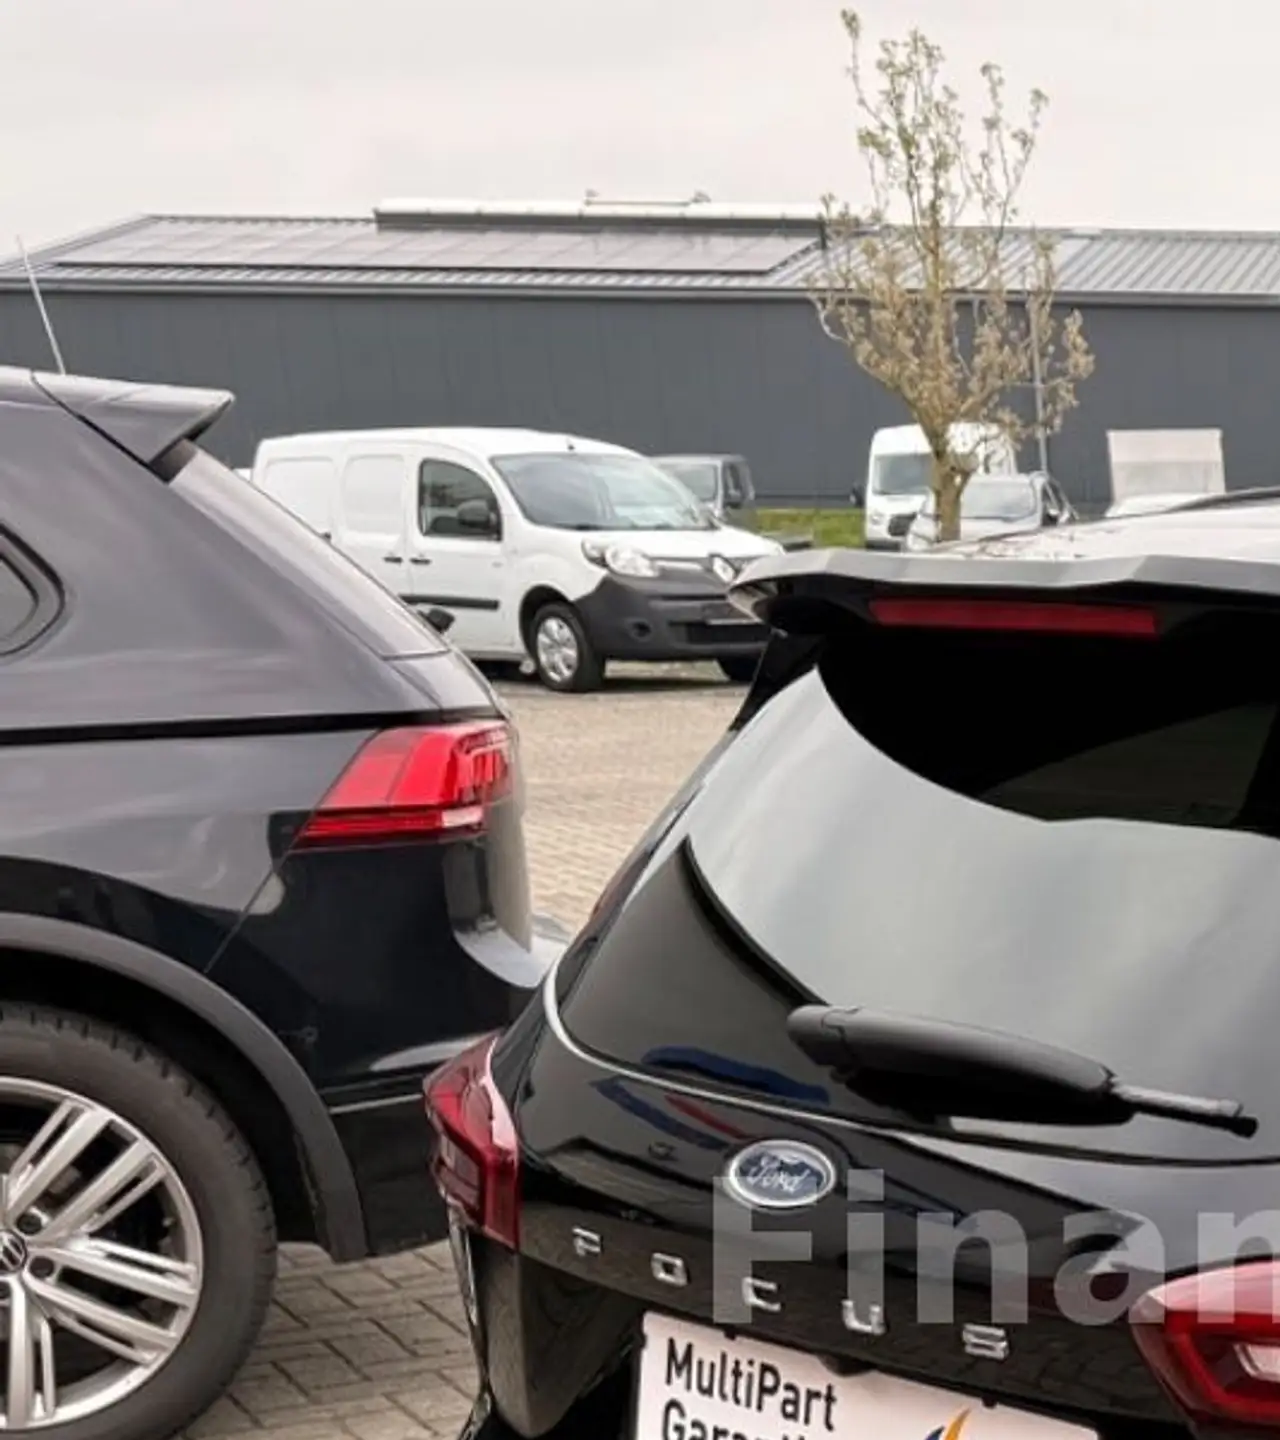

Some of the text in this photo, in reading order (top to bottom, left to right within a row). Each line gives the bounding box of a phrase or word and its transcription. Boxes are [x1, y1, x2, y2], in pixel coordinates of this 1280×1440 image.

[746, 1154, 811, 1194] Ford
[572, 1227, 1009, 1361] FOCUS
[664, 1336, 837, 1432] MultiPart
